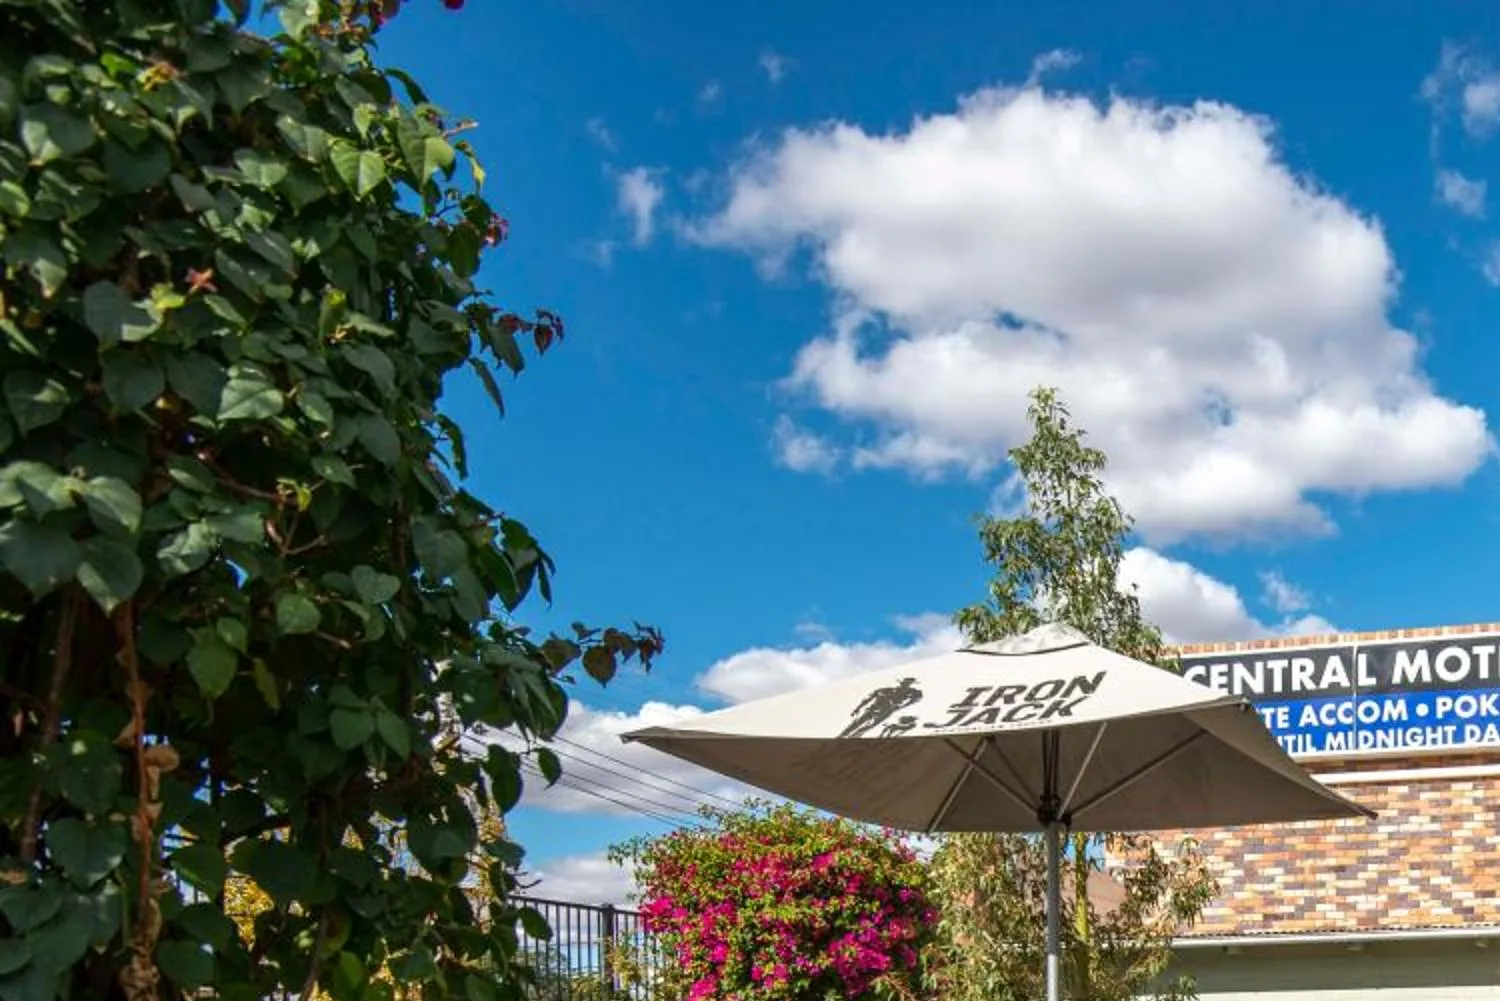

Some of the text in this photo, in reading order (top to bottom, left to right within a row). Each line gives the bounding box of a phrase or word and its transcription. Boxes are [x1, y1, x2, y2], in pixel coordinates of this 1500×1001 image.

[951, 671, 1106, 708] IRON
[923, 696, 1090, 728] JACK
[1256, 704, 1290, 729] TE
[1298, 699, 1409, 728] ACCOM
[1276, 733, 1318, 755] TIL
[1325, 725, 1457, 752] MIDNIGHT
